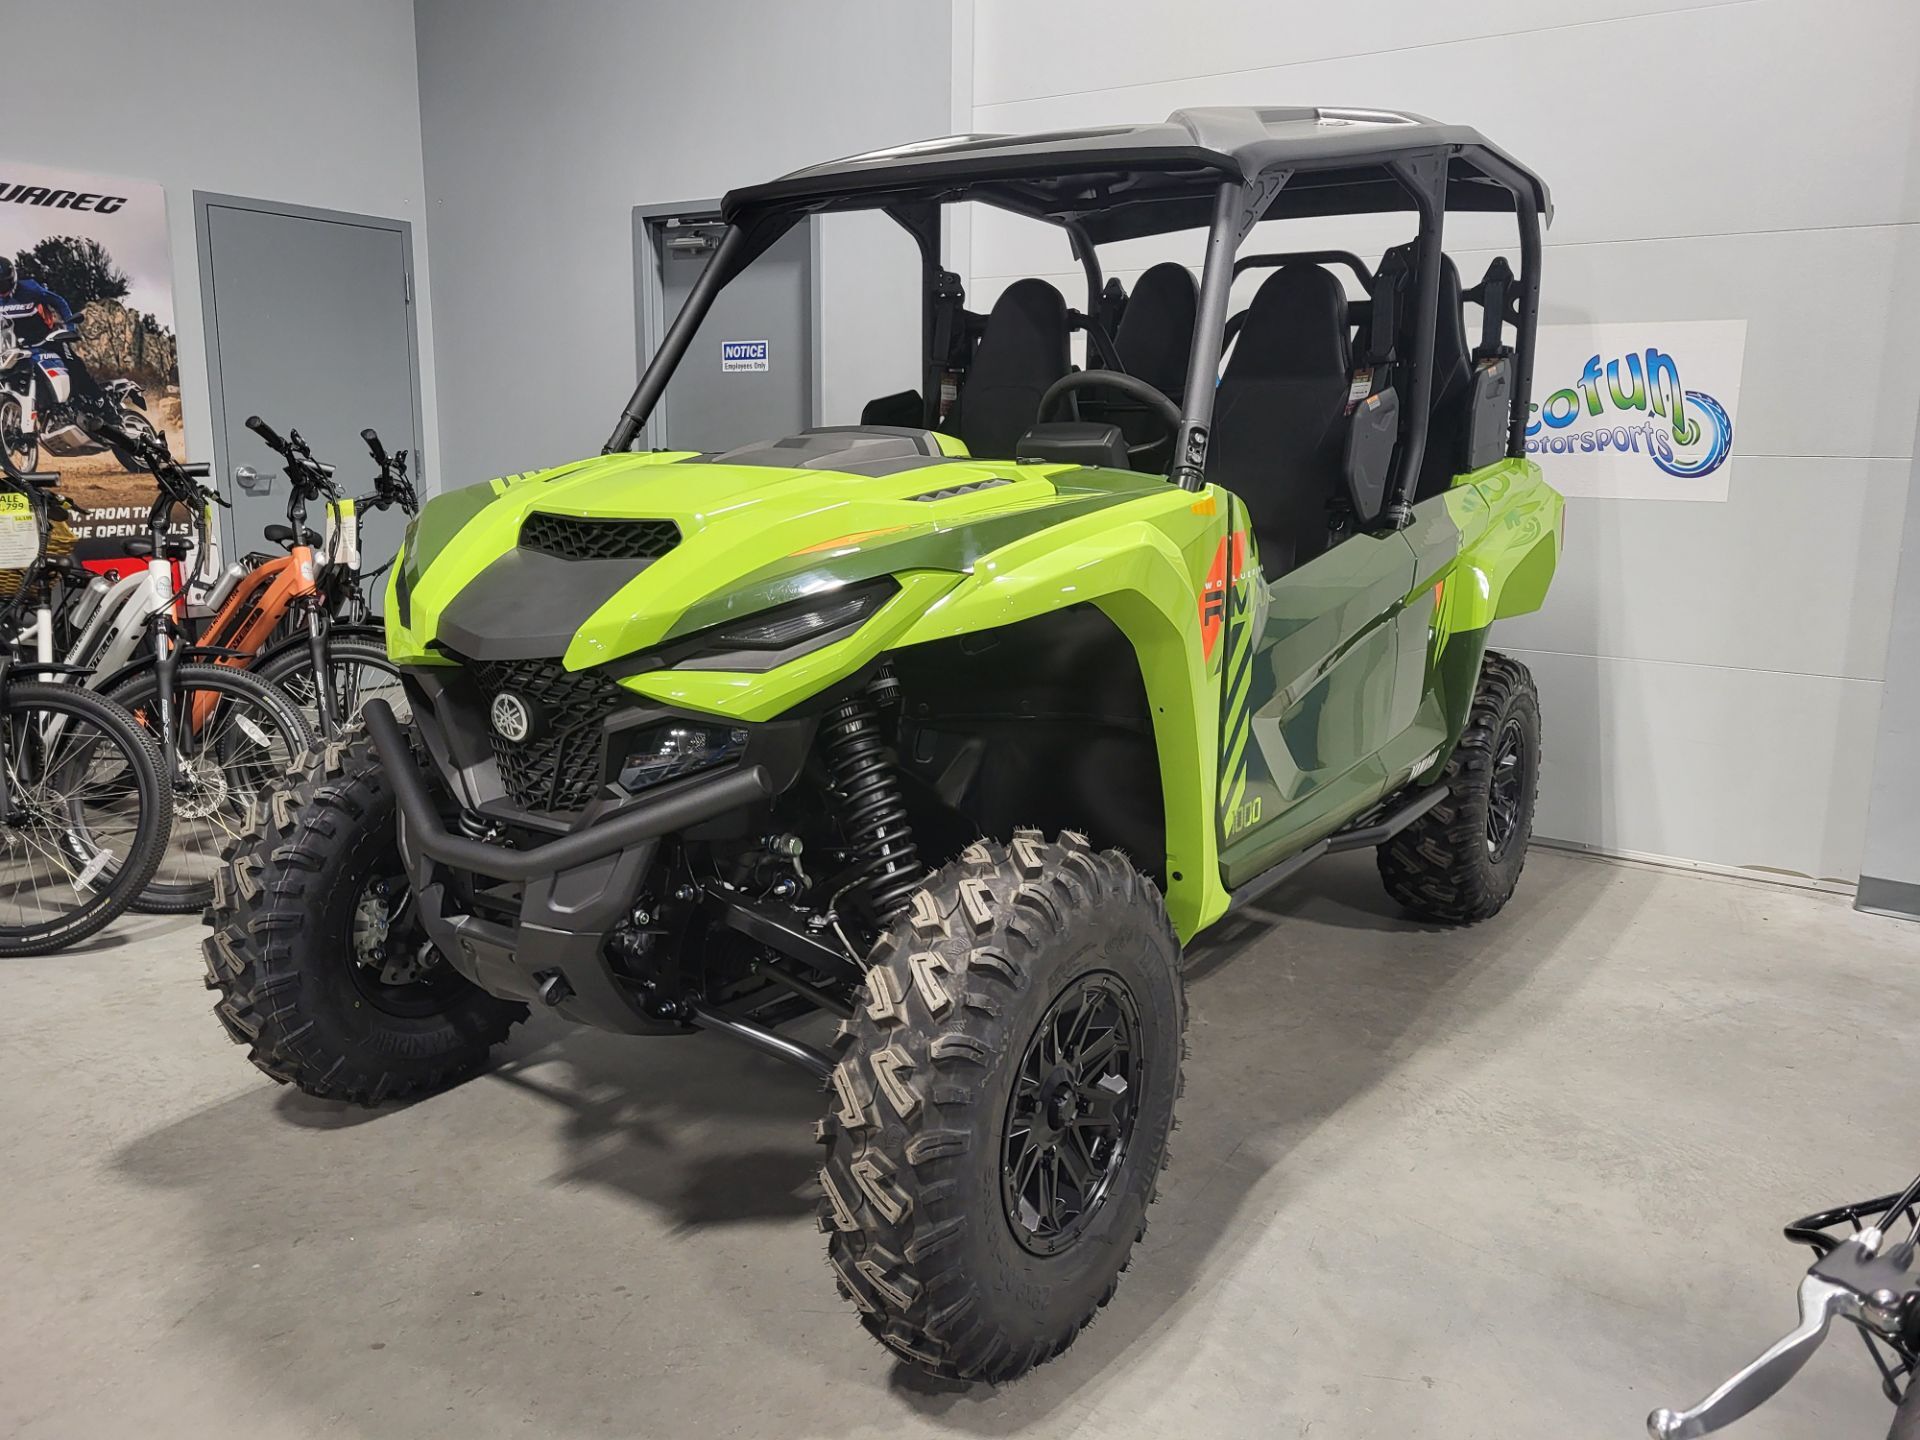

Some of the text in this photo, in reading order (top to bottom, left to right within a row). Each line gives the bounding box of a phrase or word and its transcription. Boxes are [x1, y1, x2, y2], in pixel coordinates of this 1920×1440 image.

[0, 183, 128, 214] UAREG
[725, 345, 765, 358] NOTICE
[725, 362, 766, 371] Employees Only
[1524, 348, 1686, 435] ofun
[1522, 421, 1674, 463] otorsports
[0, 495, 19, 503] ALE
[0, 503, 24, 512] ,799
[86, 507, 127, 520] FROM
[132, 506, 152, 519] TH
[69, 522, 189, 539] HE OPEN TILS
